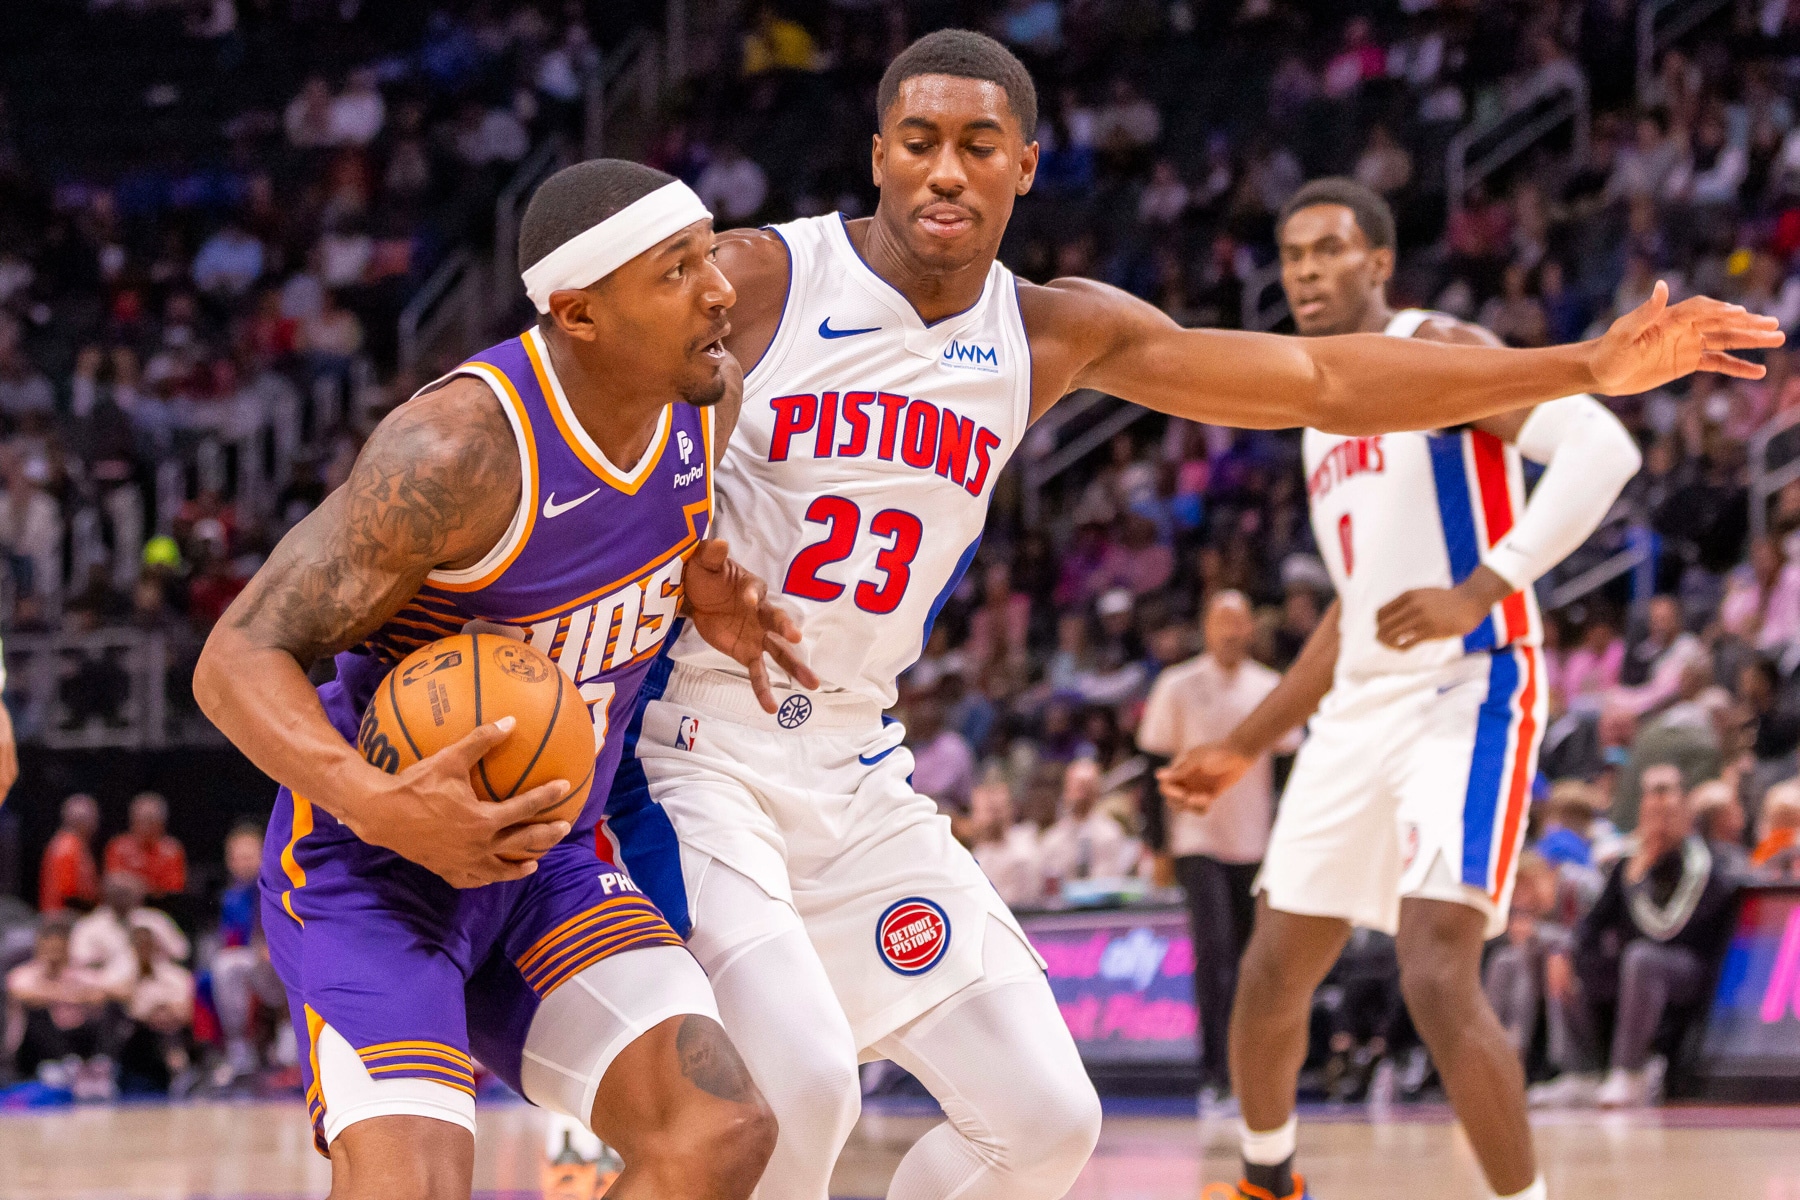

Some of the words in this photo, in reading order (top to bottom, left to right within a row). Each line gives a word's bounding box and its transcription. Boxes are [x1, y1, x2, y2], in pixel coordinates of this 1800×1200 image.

[944, 339, 998, 366] UWM
[768, 391, 1001, 497] PISTONS
[673, 462, 704, 489] PayPal
[782, 495, 923, 614] 23
[460, 556, 684, 683] UNS
[887, 915, 933, 945] DETROIT
[891, 926, 938, 957] PISTONS
